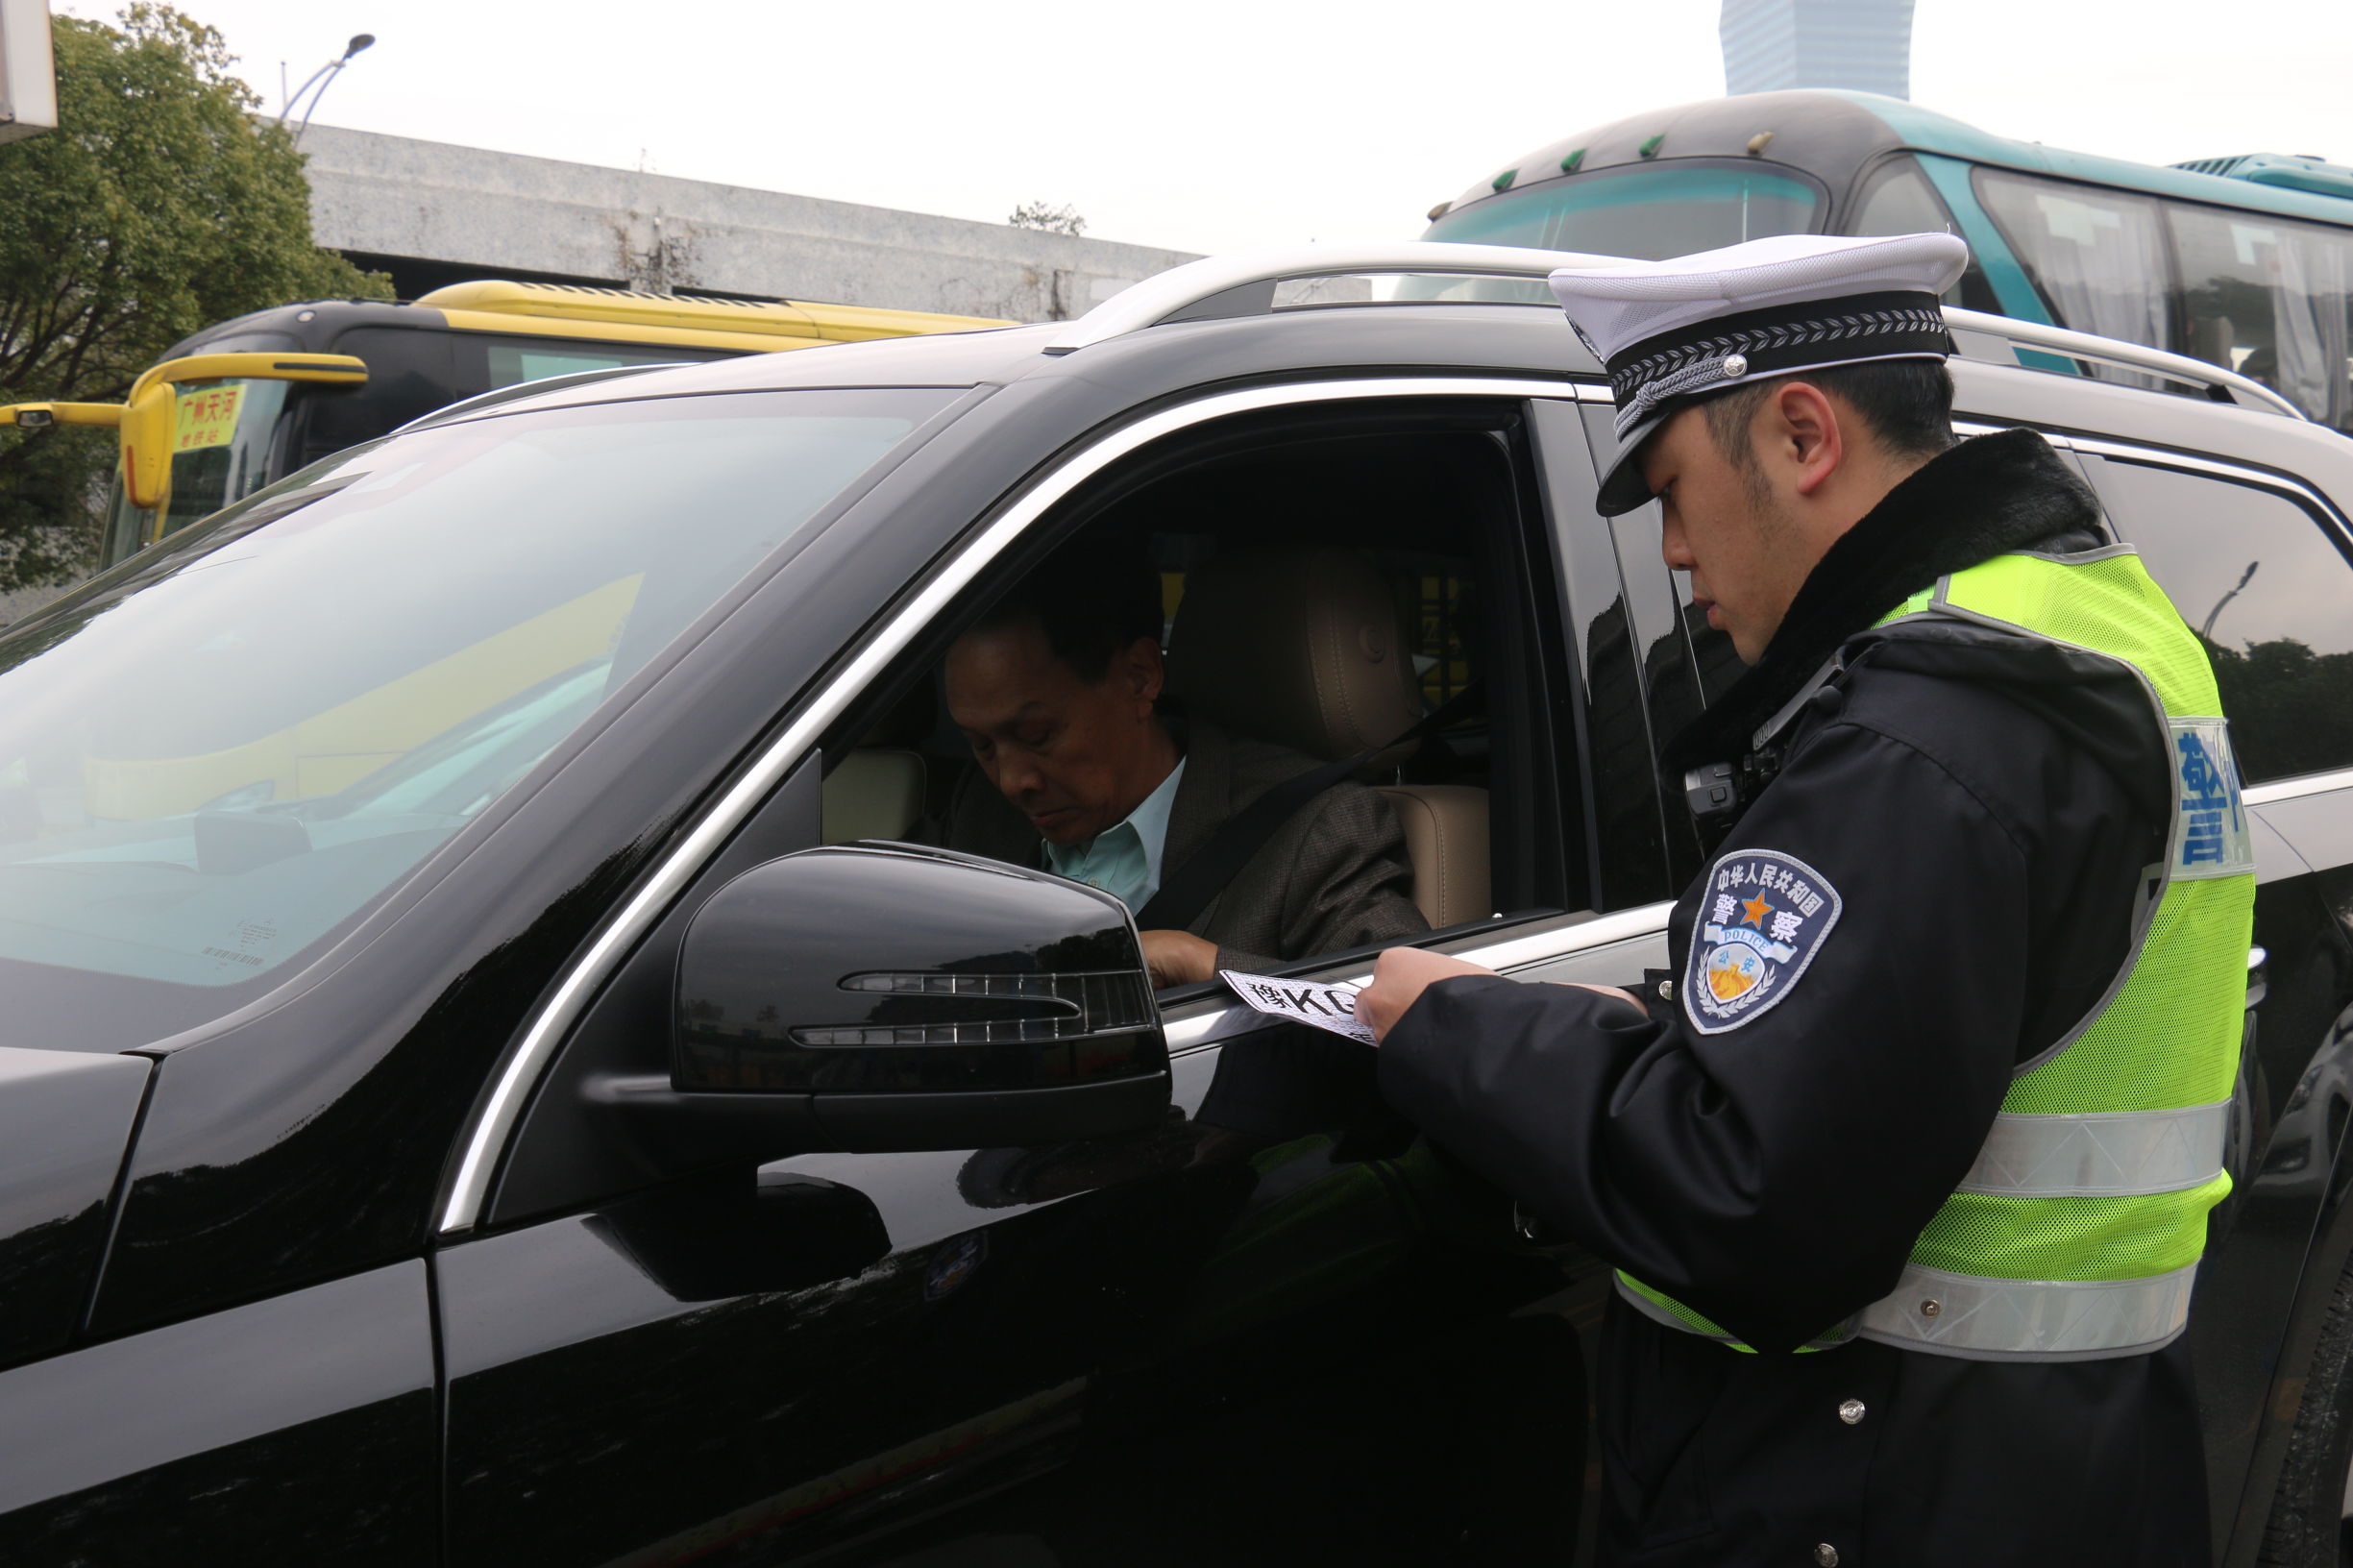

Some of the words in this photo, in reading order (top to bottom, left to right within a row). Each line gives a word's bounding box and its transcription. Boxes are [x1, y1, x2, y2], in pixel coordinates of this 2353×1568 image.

[1718, 863, 1825, 918] 中华人民共和国
[1724, 929, 1769, 952] POLICE
